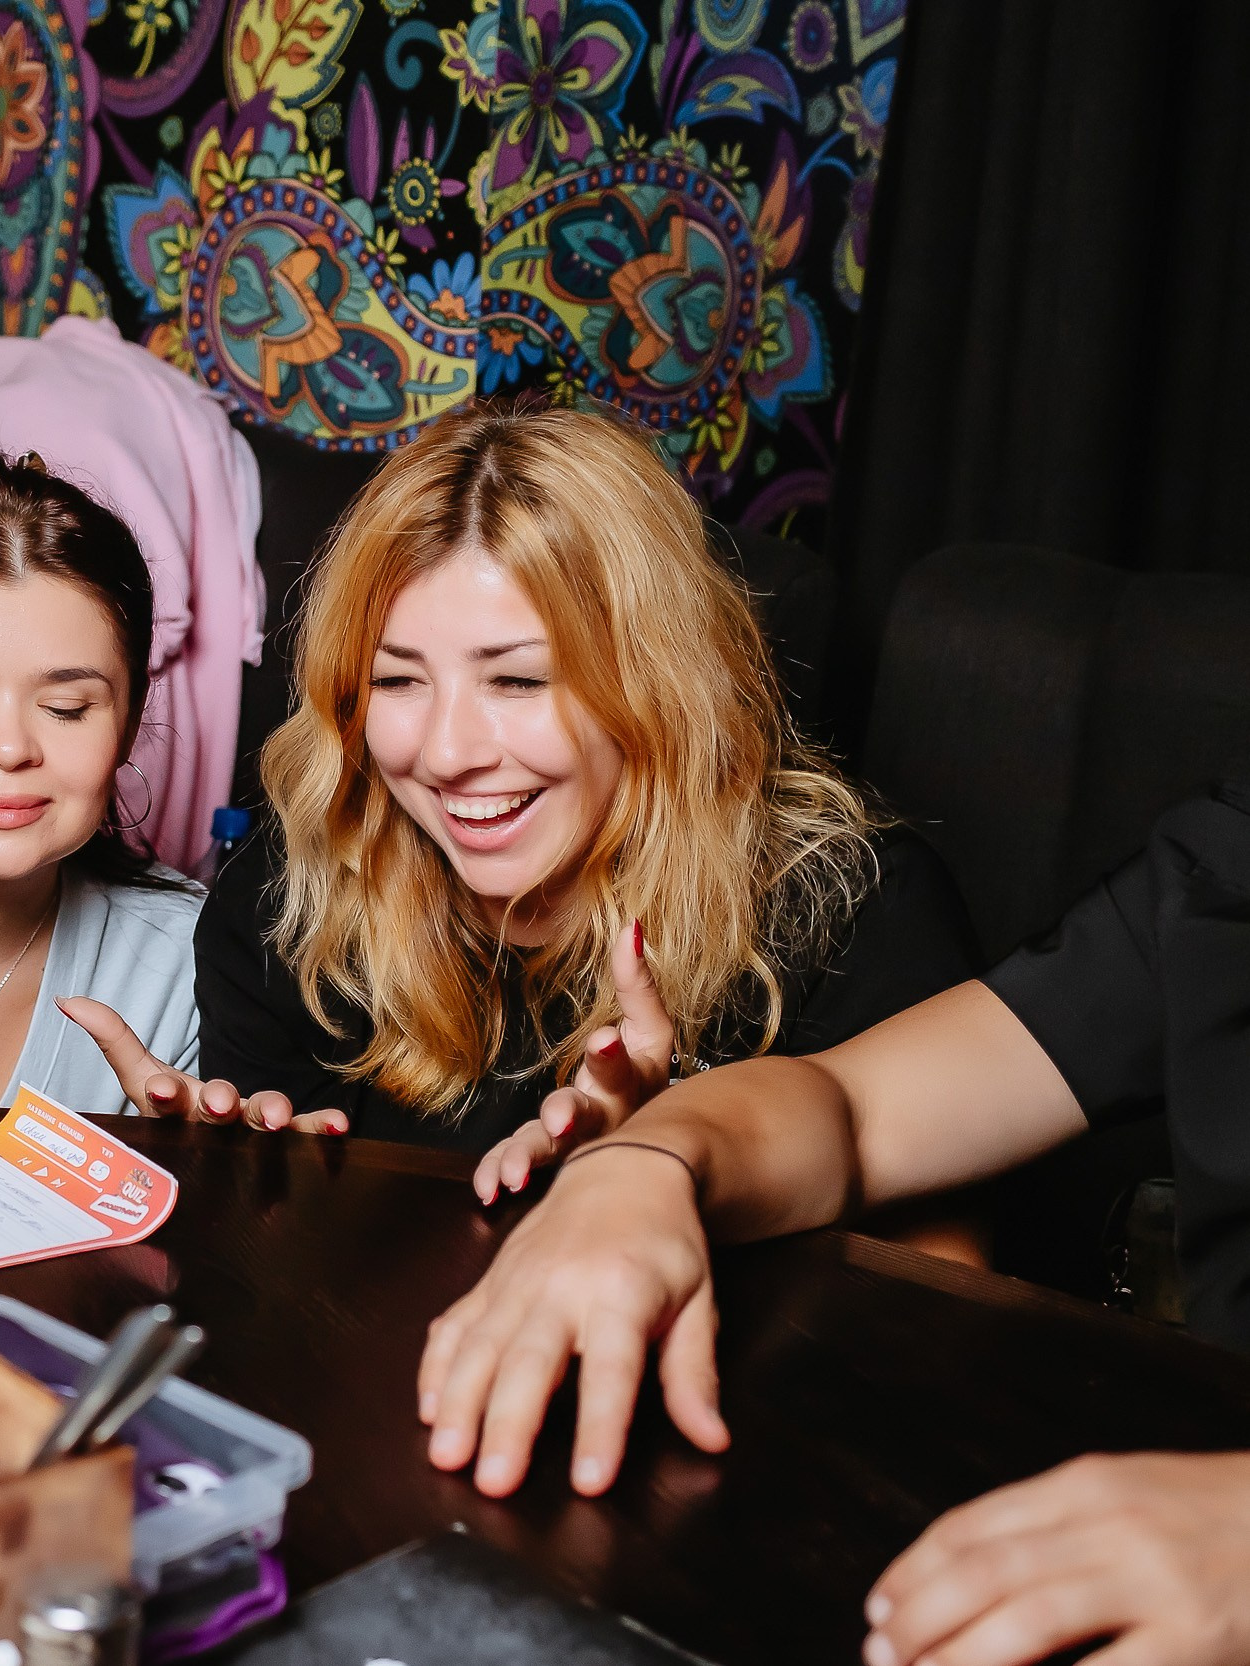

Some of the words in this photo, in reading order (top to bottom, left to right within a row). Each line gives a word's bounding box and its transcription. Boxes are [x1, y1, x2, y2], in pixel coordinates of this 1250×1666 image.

[26, 1102, 57, 1125] НАЗВАНИЕ
[57, 1122, 85, 1143] КОМАНДЫ
[121, 1182, 148, 1203] QUIZ
